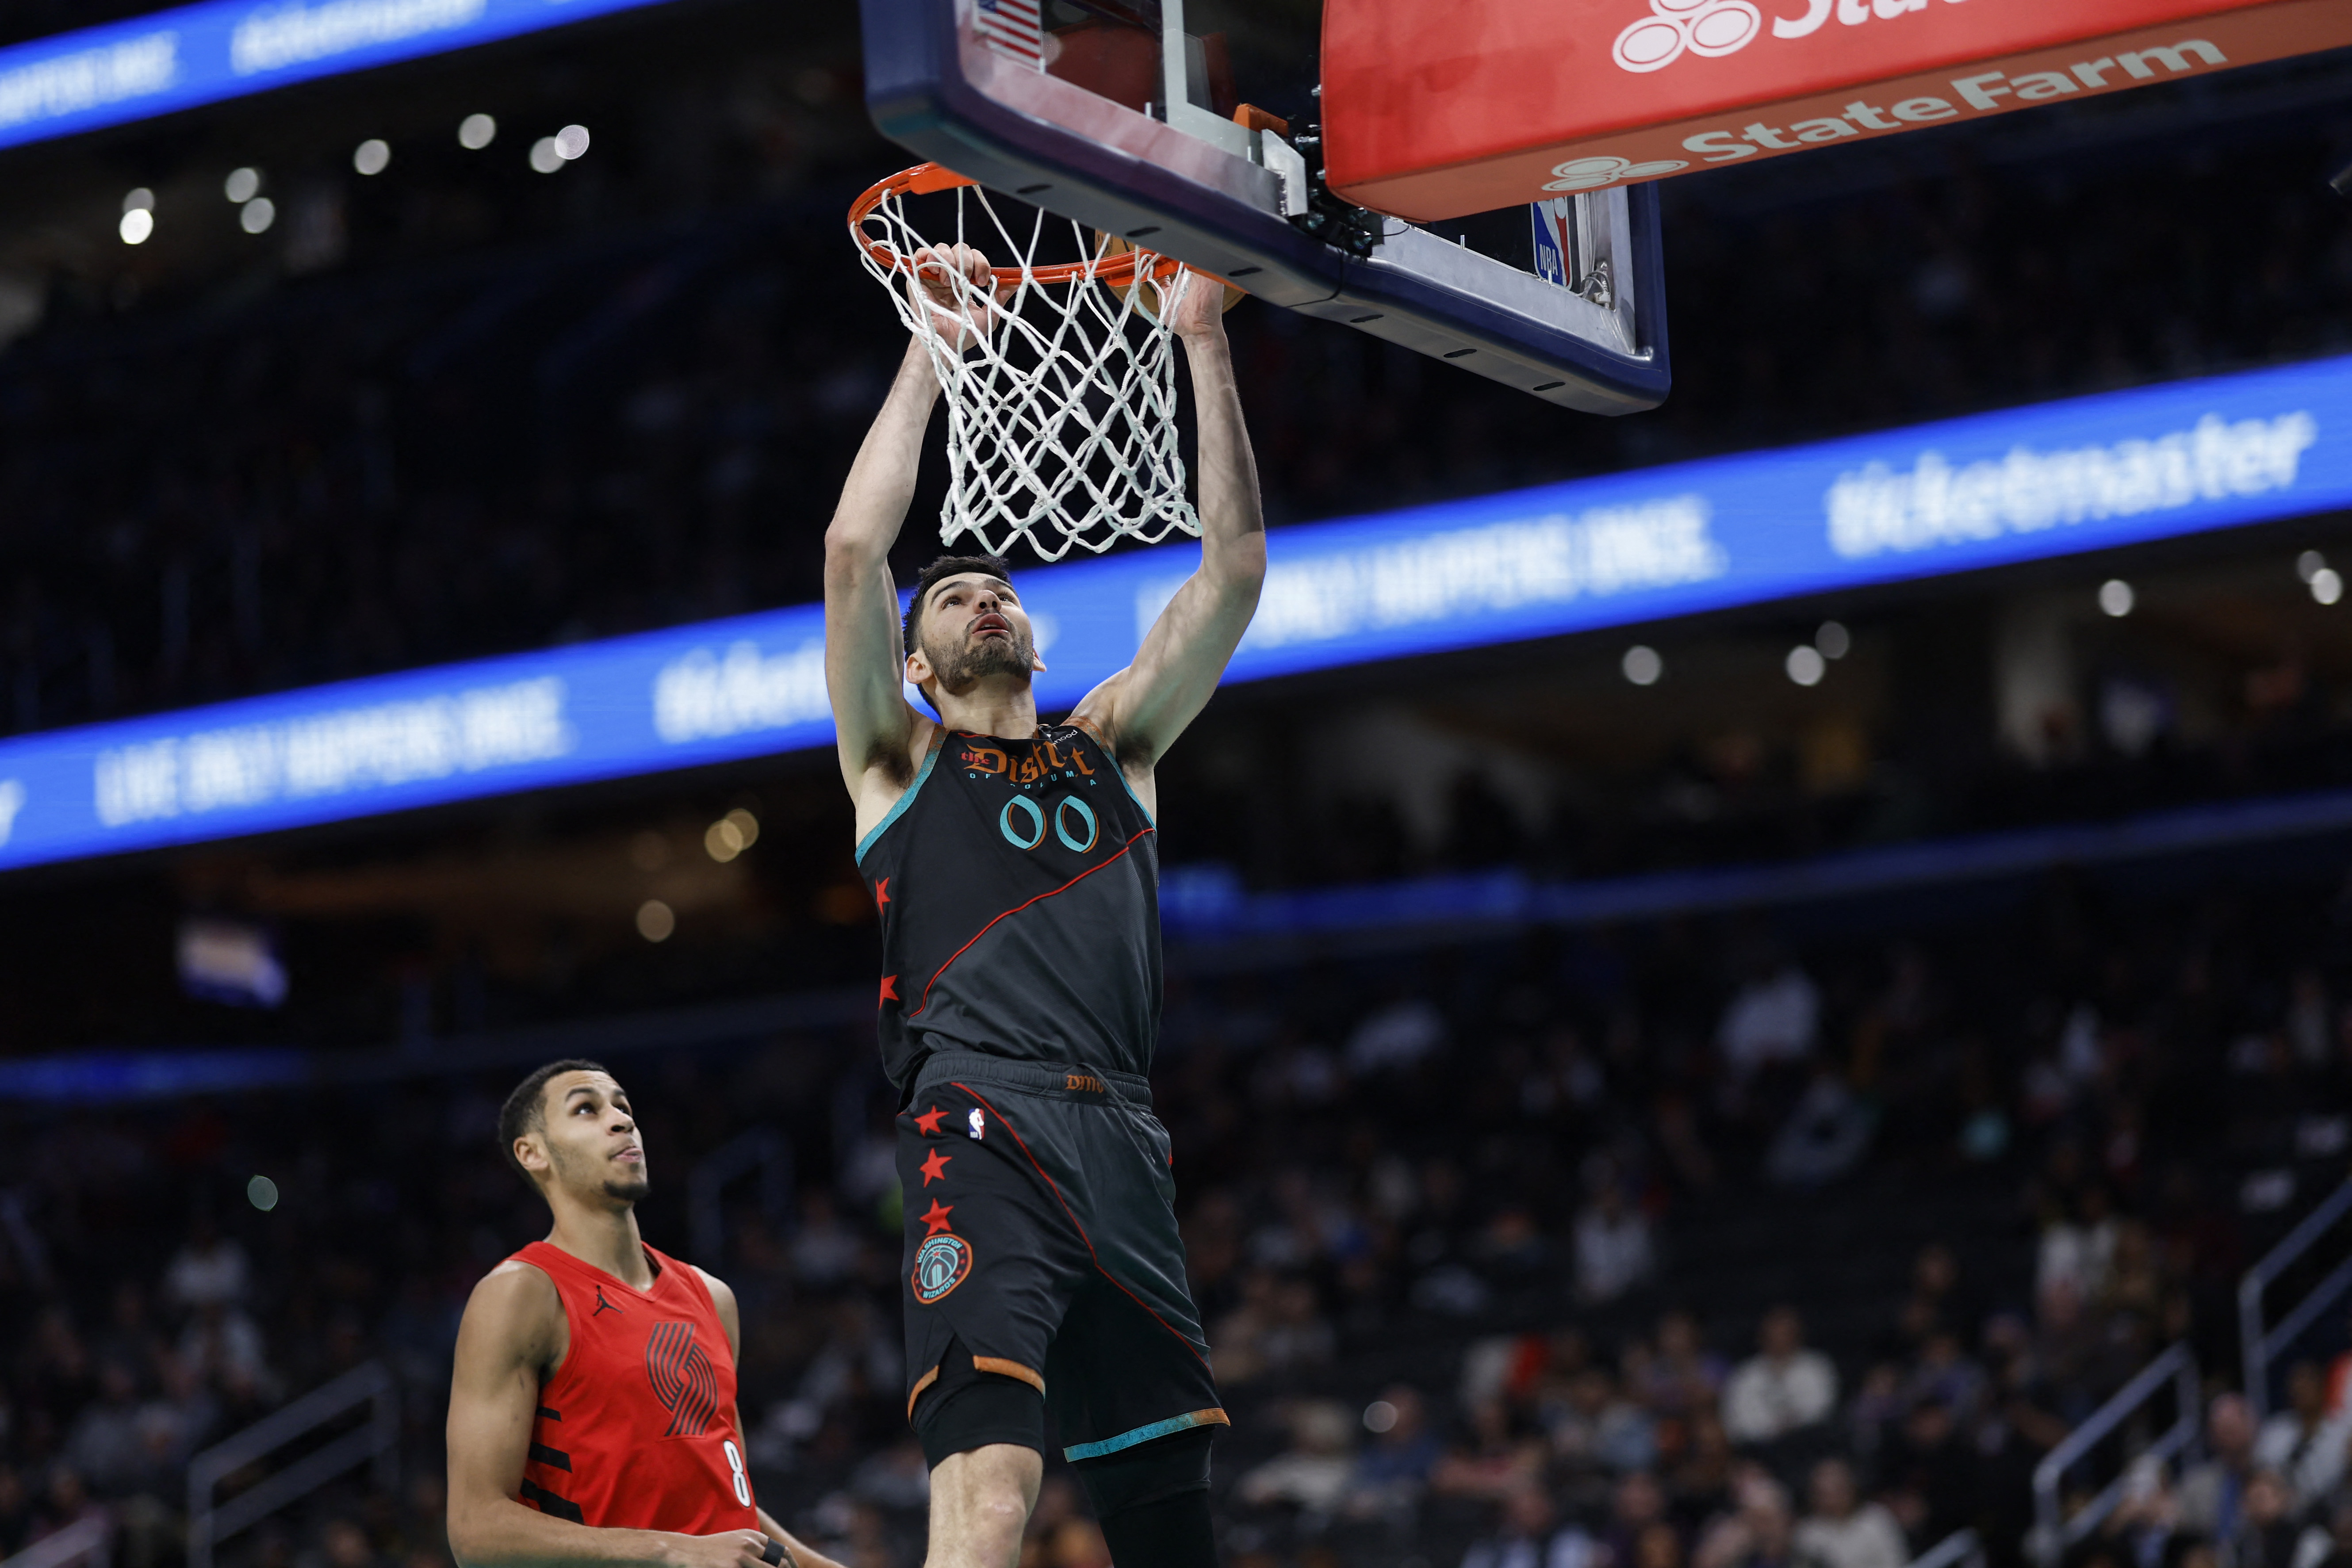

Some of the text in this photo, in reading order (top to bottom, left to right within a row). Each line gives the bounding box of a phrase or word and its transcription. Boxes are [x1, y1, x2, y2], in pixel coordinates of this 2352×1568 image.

[1539, 243, 1559, 276] NBA
[961, 751, 991, 765] the
[999, 794, 1100, 854] 00
[917, 1237, 963, 1264] WASHINGTON
[923, 1277, 956, 1299] WIZARDS
[723, 1439, 751, 1508] 8
